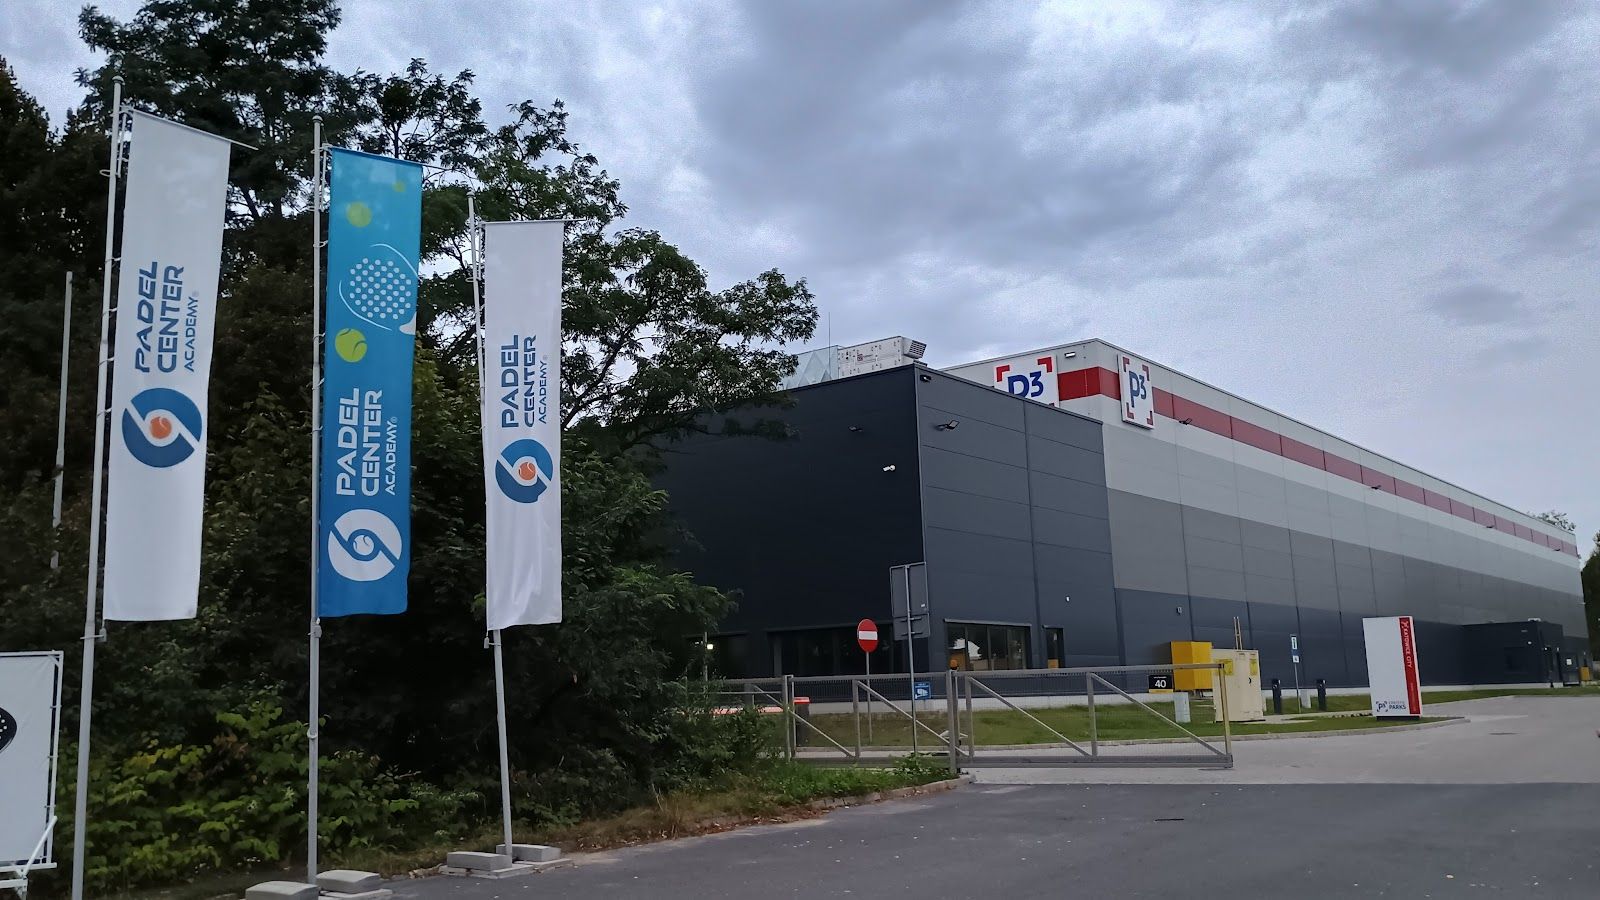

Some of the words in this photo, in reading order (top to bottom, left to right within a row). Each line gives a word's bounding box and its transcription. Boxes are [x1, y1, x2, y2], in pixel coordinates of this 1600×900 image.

[135, 261, 158, 373] PADEL
[157, 265, 184, 373] CENTER
[184, 296, 198, 372] ACADEMY
[501, 335, 519, 428] PADEL
[523, 334, 537, 428] CENTER
[336, 387, 360, 496] PADEL
[361, 390, 383, 497] CENTER
[1154, 679, 1167, 688] 40
[1403, 628, 1412, 655] KATOWICE
